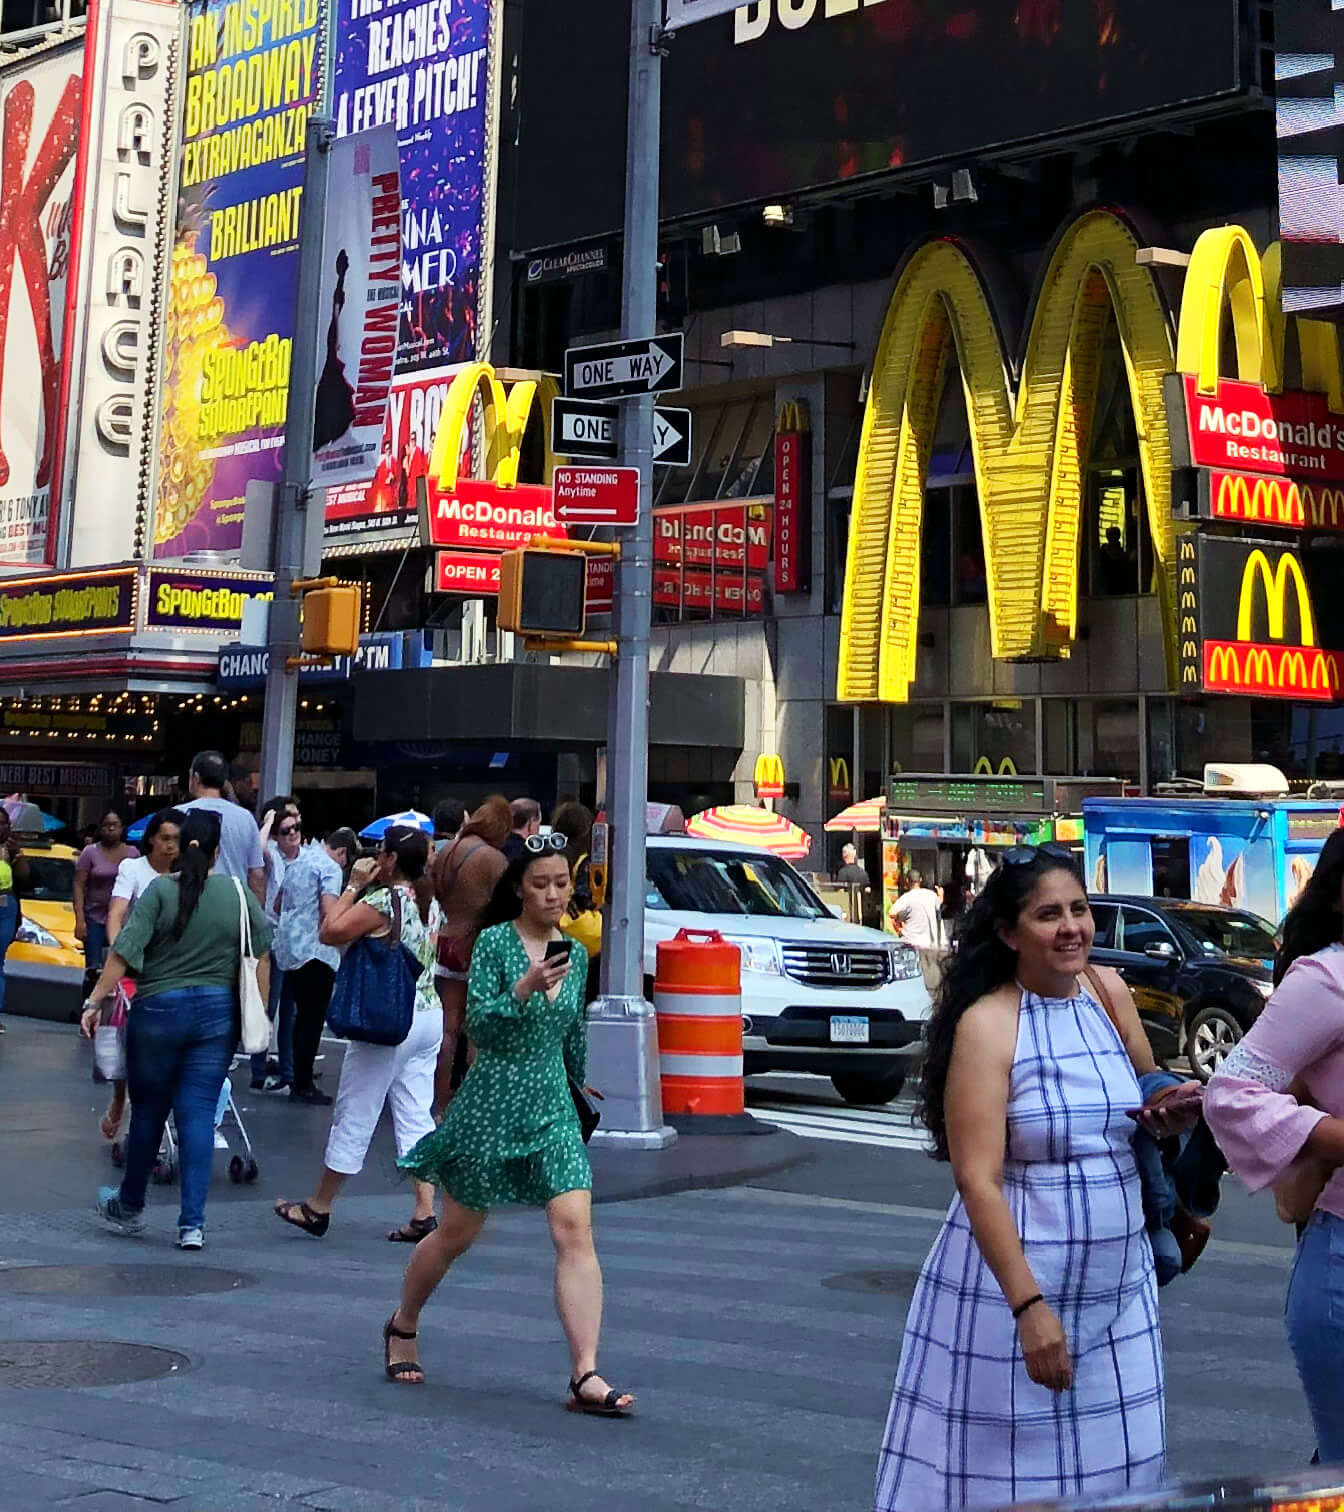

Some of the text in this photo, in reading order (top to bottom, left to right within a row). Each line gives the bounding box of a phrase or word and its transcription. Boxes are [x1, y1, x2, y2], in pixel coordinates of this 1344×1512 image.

[186, 33, 316, 138] BROADWAY
[337, 92, 349, 139] A
[97, 30, 161, 459] PALACE
[368, 171, 401, 281] PRETTY
[203, 333, 293, 403] SPONGEBO
[352, 303, 400, 428] WOMAN
[582, 355, 664, 384] ONE WAY
[200, 388, 289, 437] SQUAREPANT
[573, 418, 612, 441] ONE
[558, 472, 618, 484] NO STANDING
[782, 441, 790, 493] OPEN
[1226, 441, 1326, 470] Restaurant
[7, 499, 14, 516] 6
[16, 495, 37, 521] TONY
[558, 486, 596, 498] Anytime
[8, 523, 31, 538] BEST
[781, 517, 789, 582] HOURS
[444, 564, 500, 581] OPEN 2
